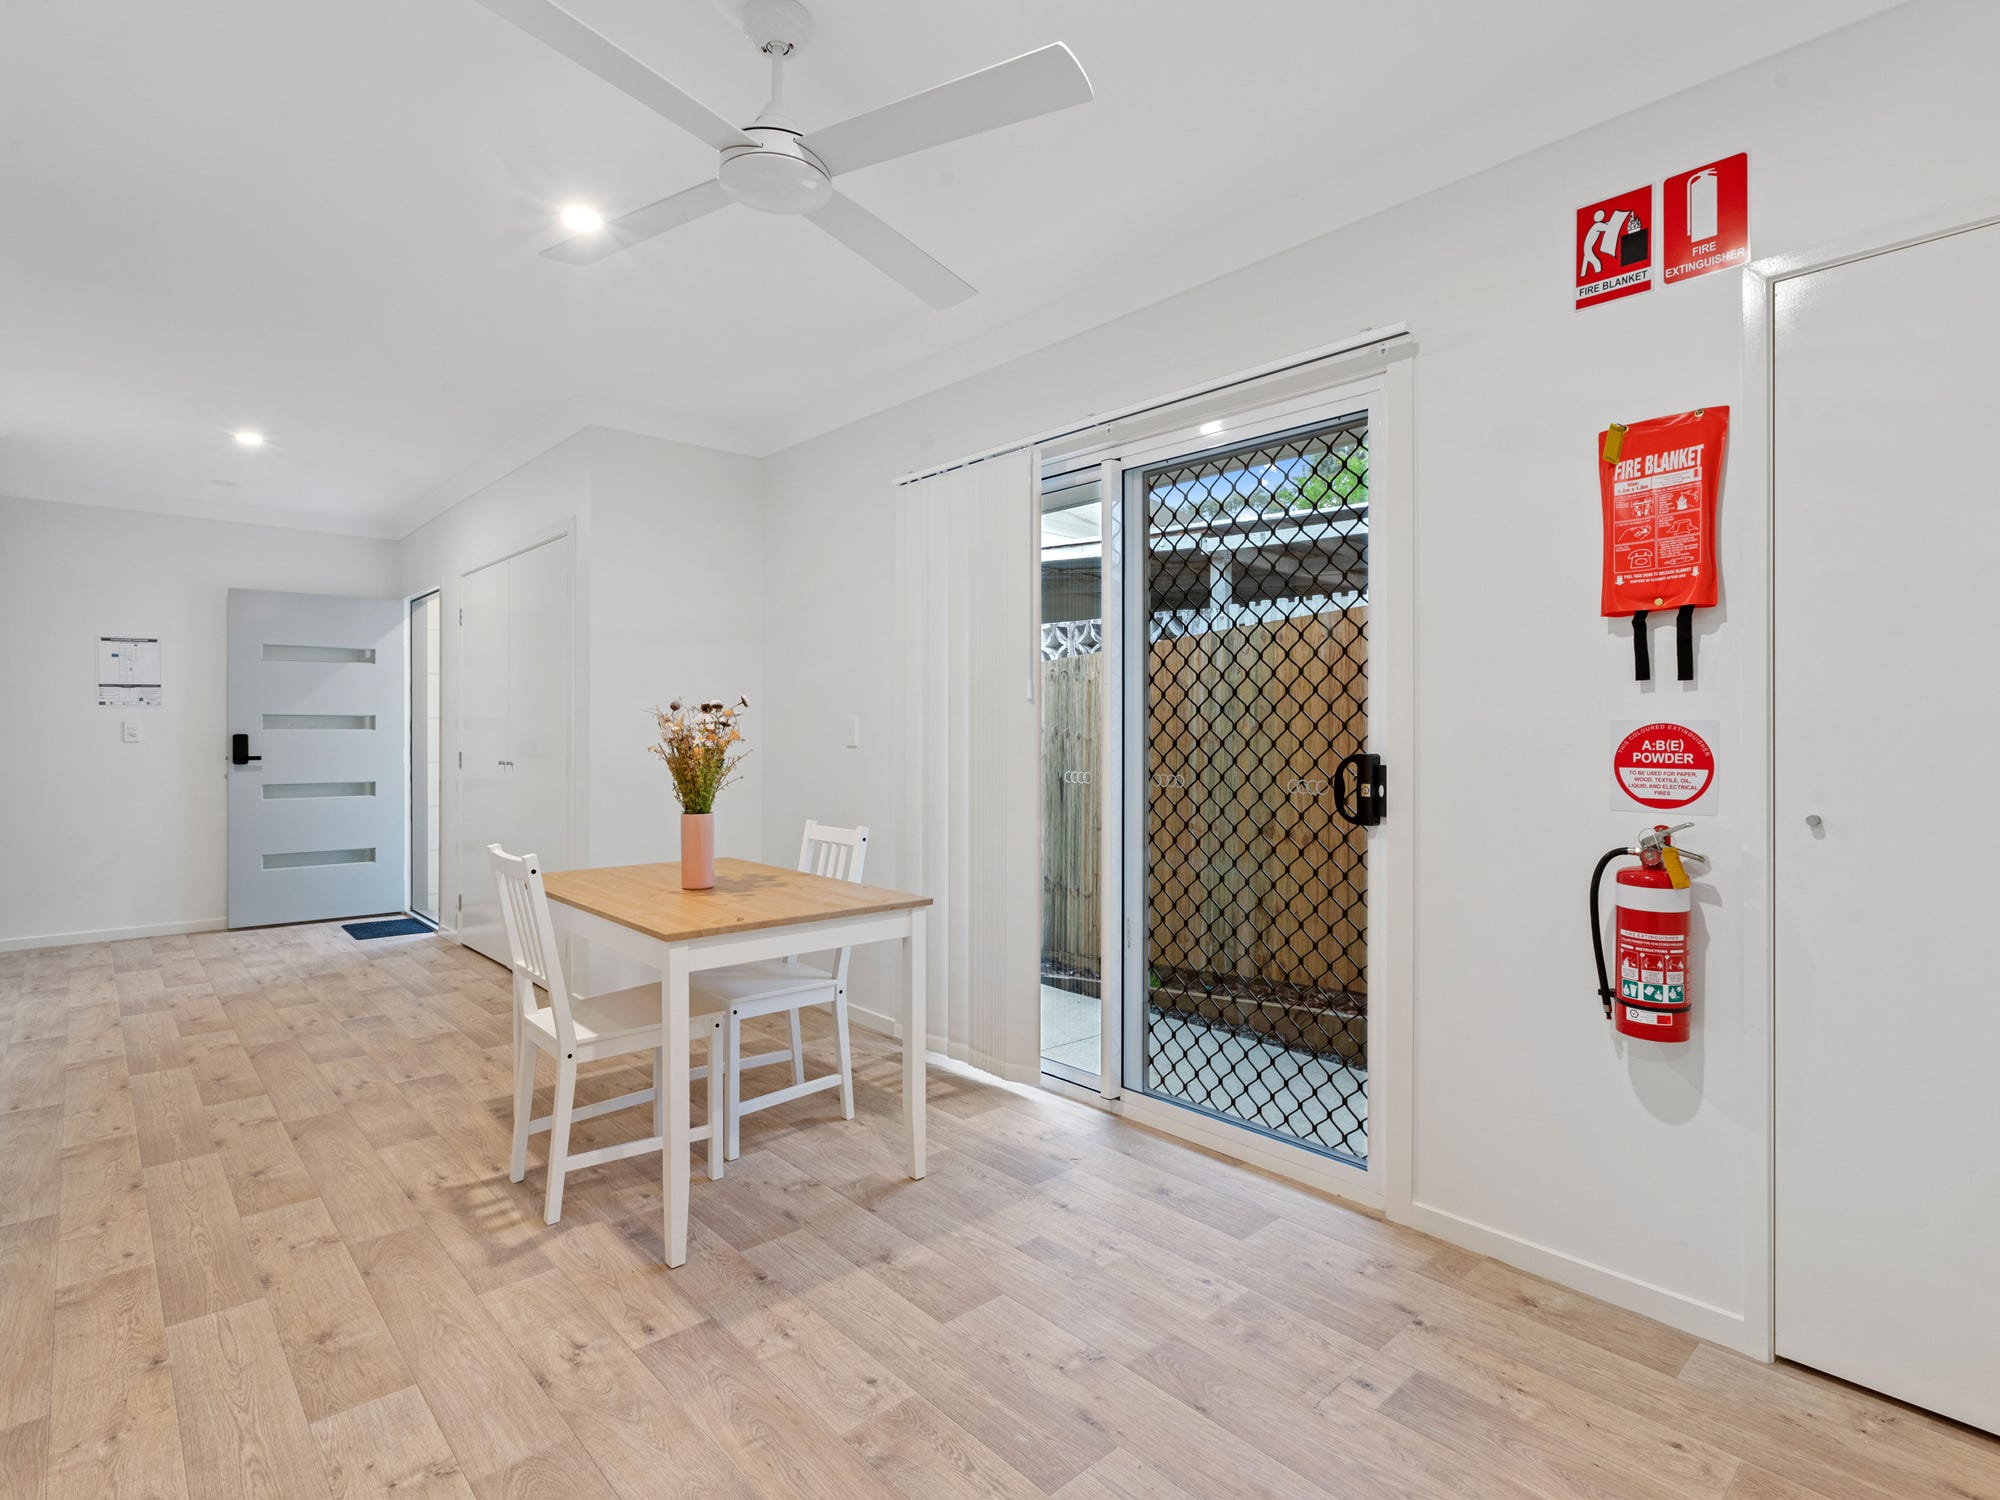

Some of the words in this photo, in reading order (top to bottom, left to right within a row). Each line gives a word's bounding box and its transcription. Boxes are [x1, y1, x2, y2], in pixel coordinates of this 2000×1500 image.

[1692, 241, 1717, 256] FIRE
[1665, 247, 1746, 279] EXTINGUISHER
[1579, 283, 1600, 297] FIRE
[1602, 269, 1648, 291] BLANKET
[1614, 456, 1642, 481] FIRE
[1644, 443, 1704, 476] BLANKET
[1618, 740, 1630, 754] THIS
[1628, 724, 1665, 741] COLOURED
[1667, 724, 1711, 757] EXTINGUISHER
[1641, 738, 1684, 752] A:B(E)
[1632, 752, 1694, 764] POWDER
